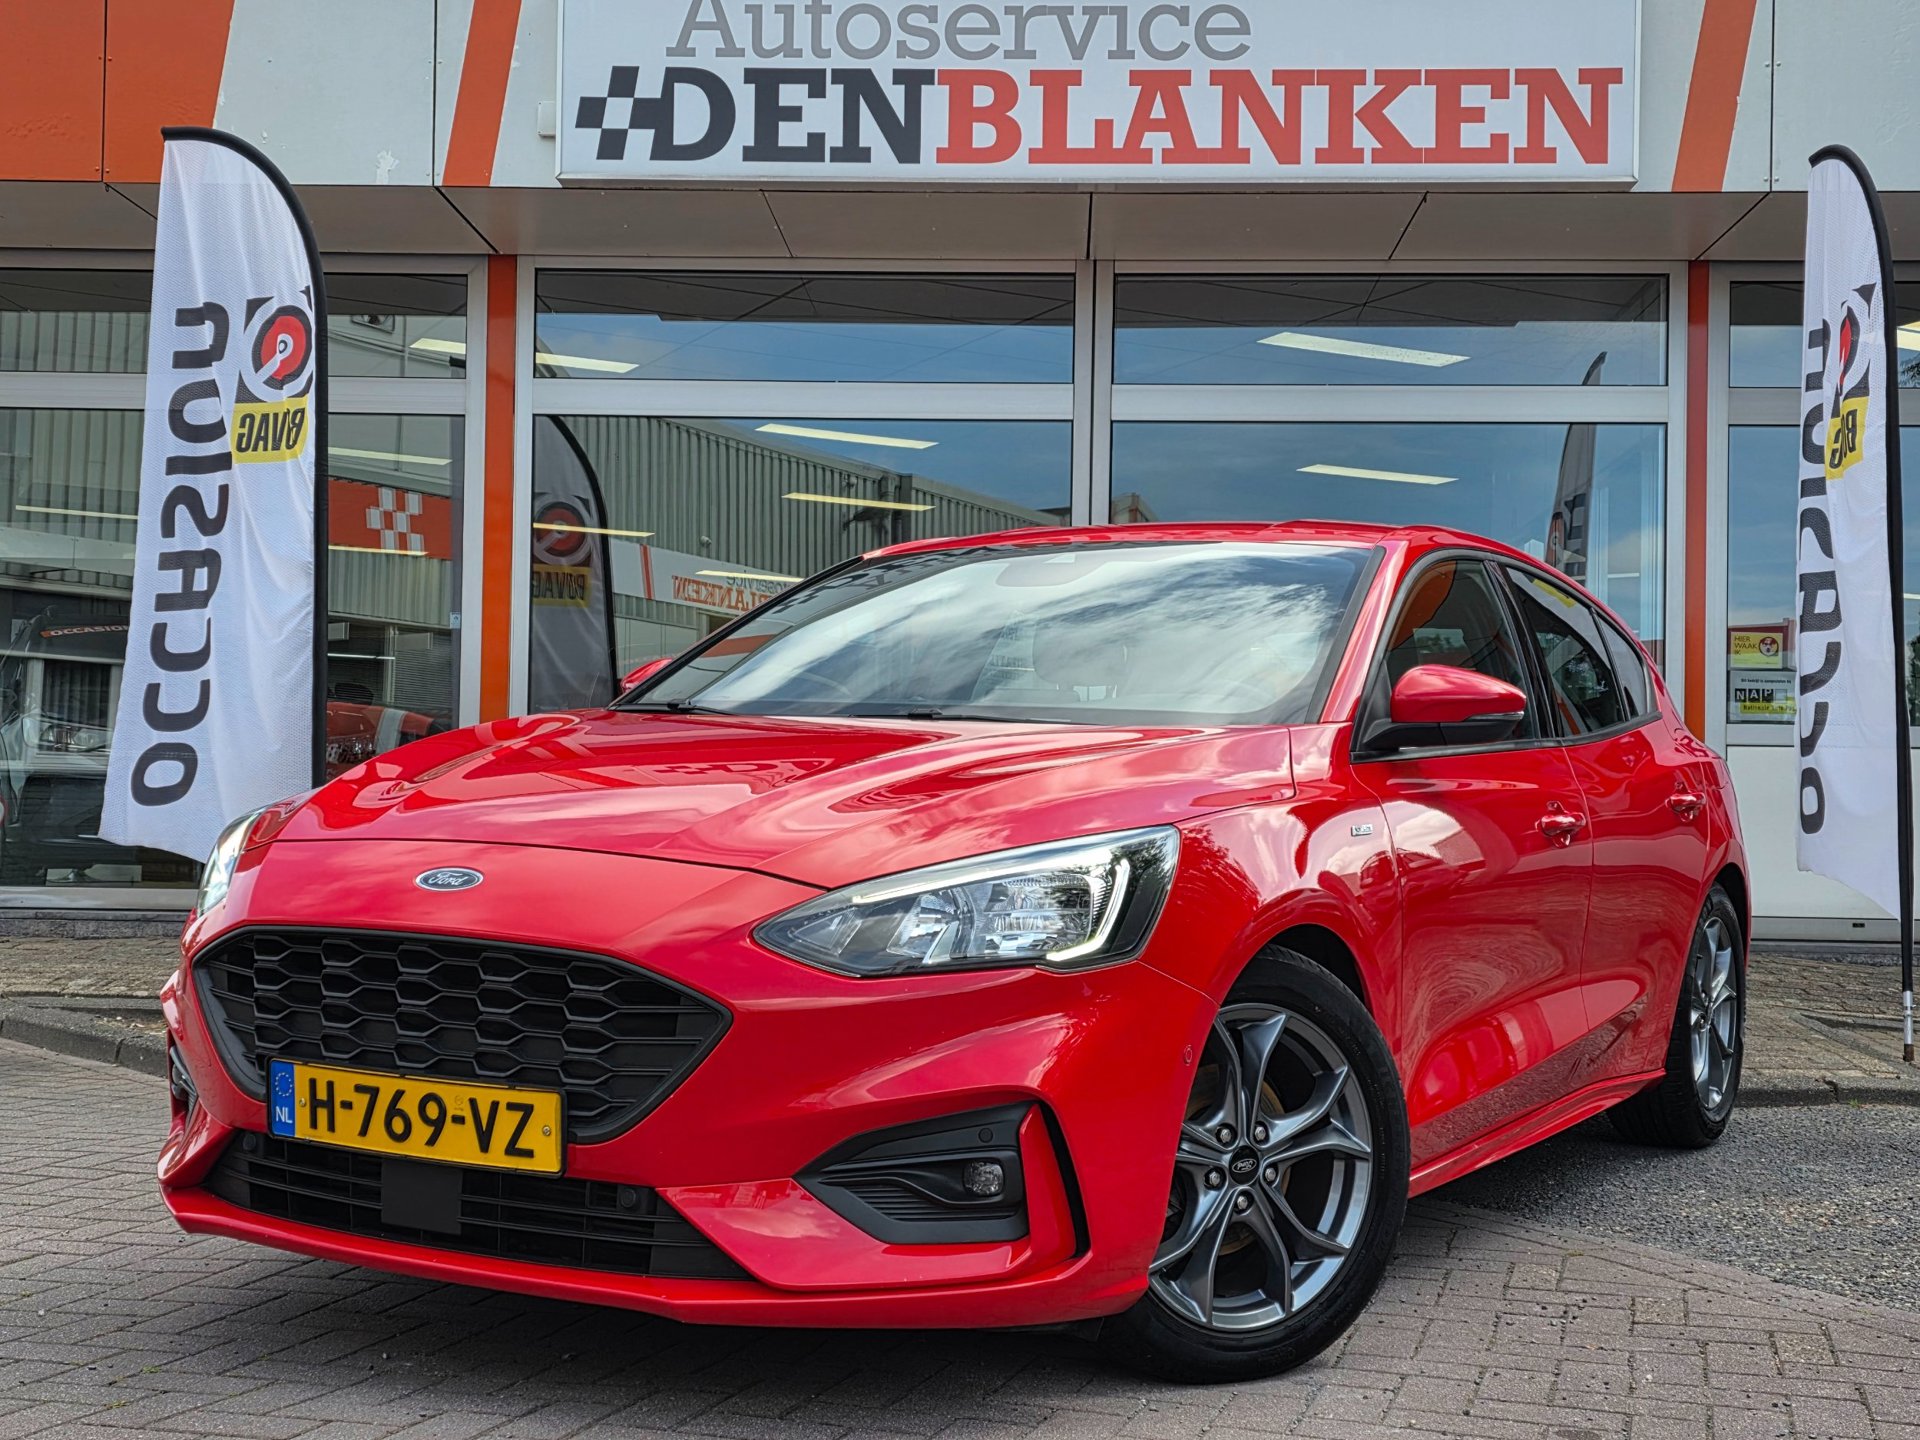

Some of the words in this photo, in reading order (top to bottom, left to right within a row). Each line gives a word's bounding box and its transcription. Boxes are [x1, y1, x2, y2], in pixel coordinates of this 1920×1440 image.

[665, 0, 1252, 61] Autoservice
[1734, 642, 1758, 650] WAAK
[1736, 689, 1772, 700] NAP
[428, 871, 469, 886] Ford
[275, 1105, 293, 1124] NL
[308, 1077, 535, 1159] H-769-VZ
